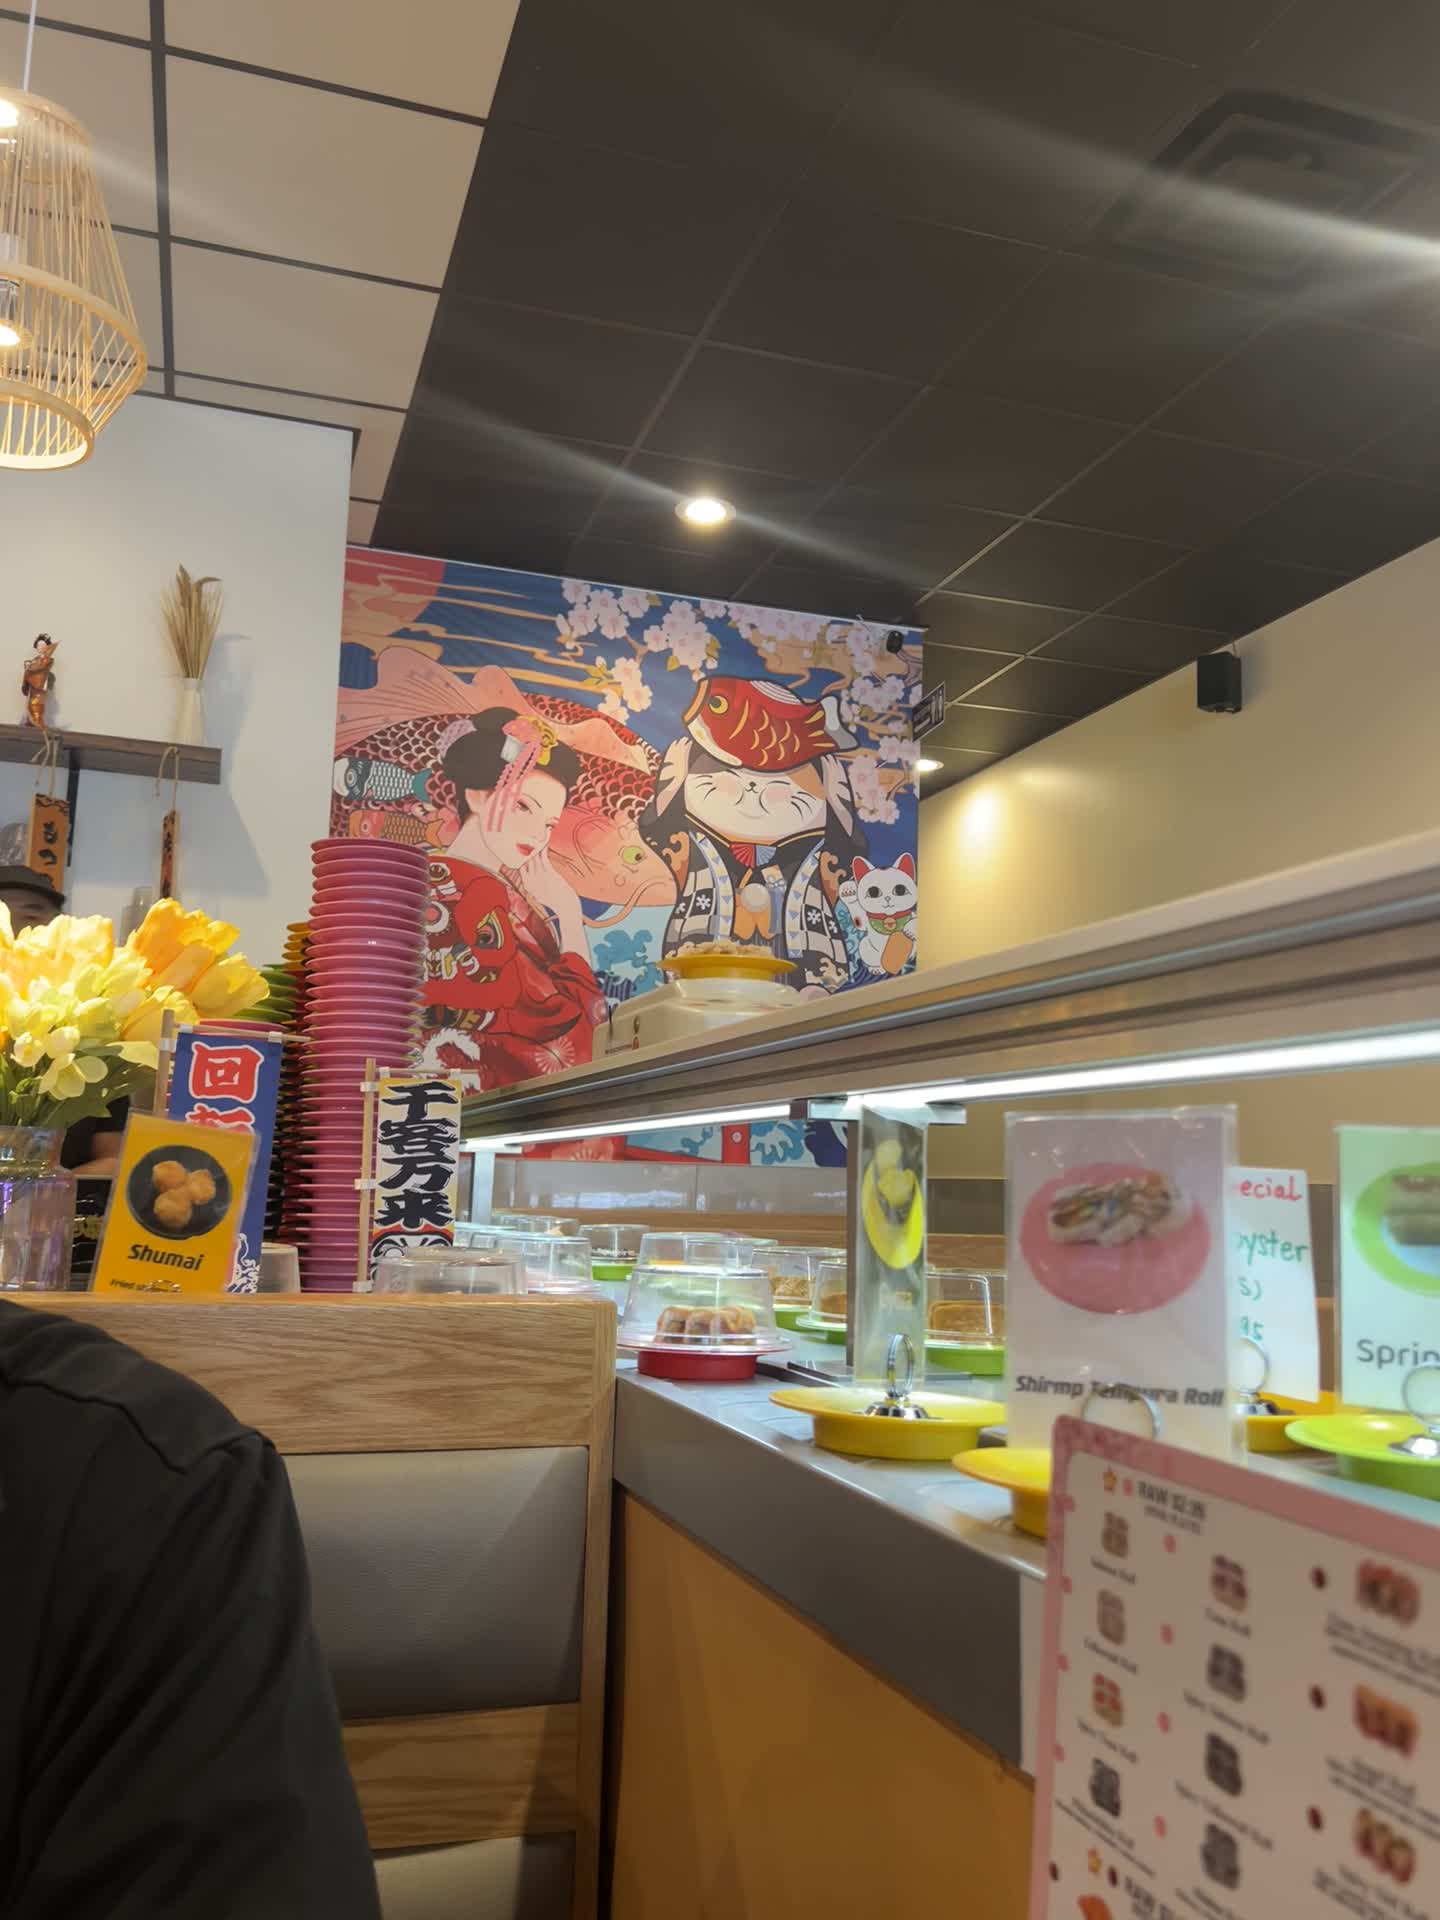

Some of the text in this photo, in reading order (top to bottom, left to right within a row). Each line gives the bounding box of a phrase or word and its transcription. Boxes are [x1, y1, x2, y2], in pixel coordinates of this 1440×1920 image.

[375, 1081, 458, 1228] 千客万来
[128, 1244, 204, 1270] Shumai
[1184, 1387, 1224, 1406] Roll
